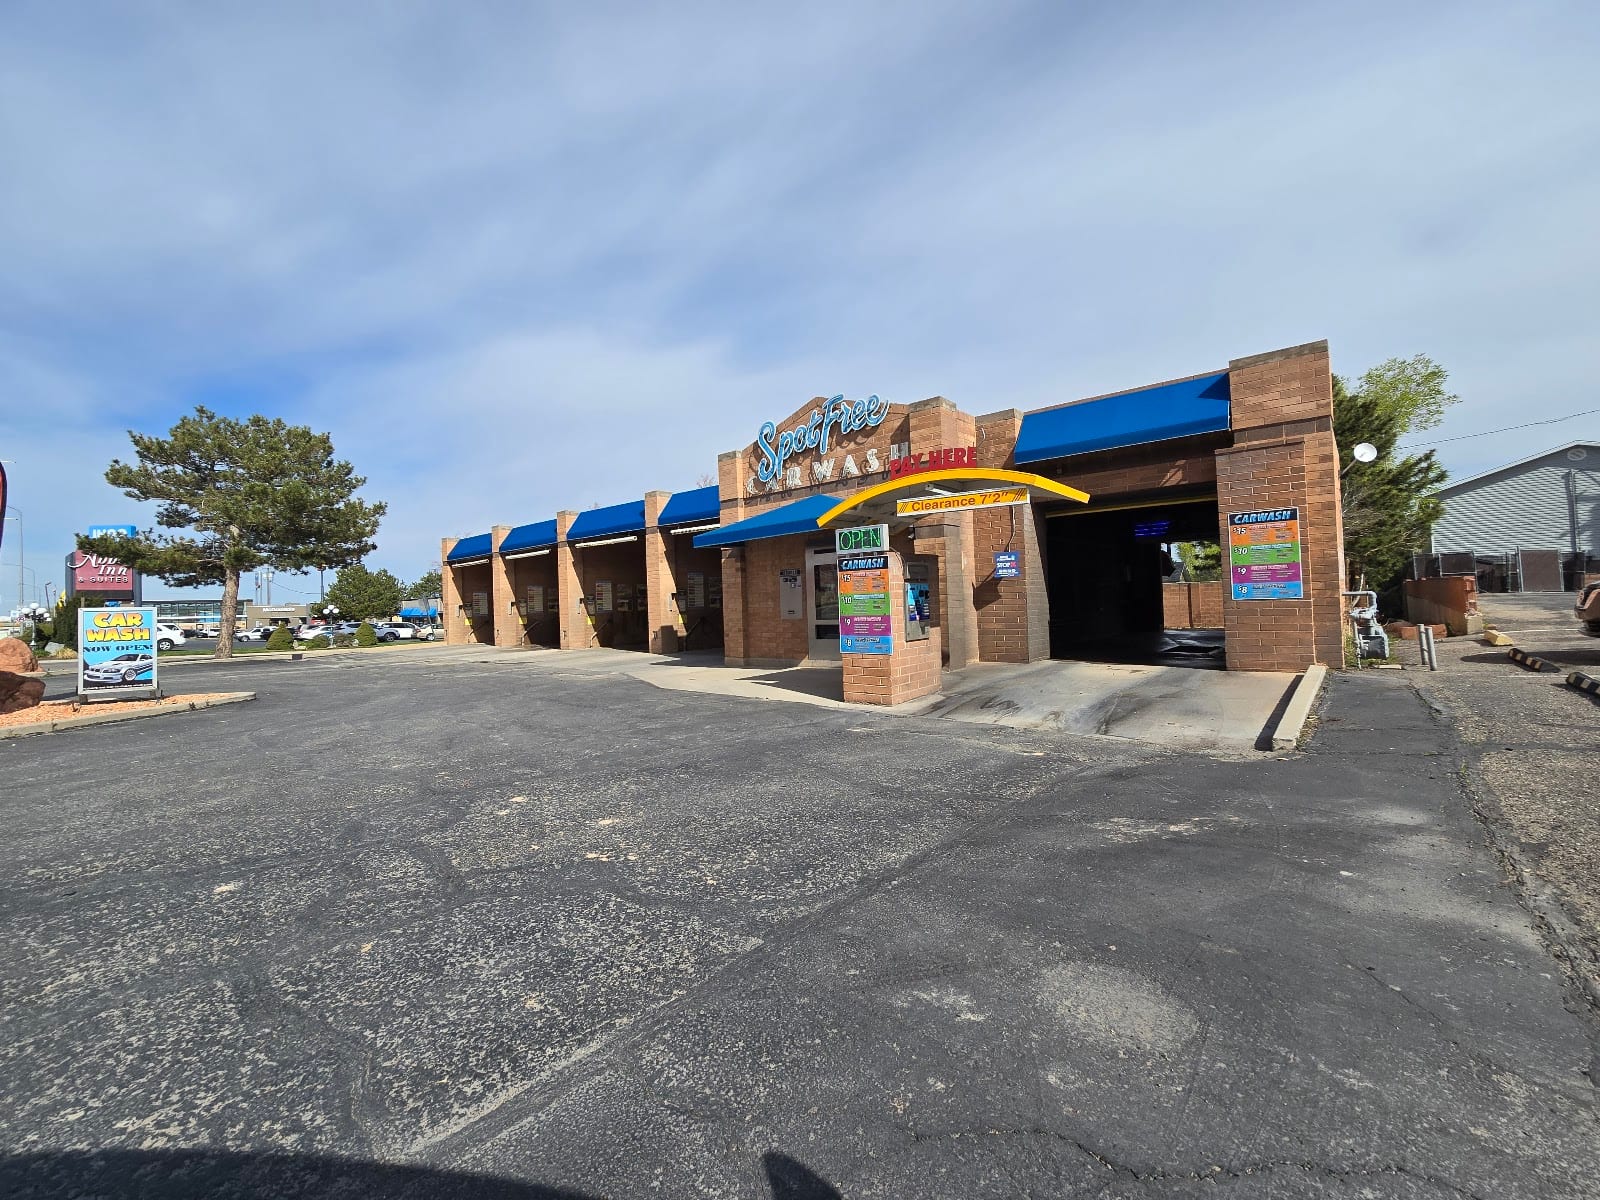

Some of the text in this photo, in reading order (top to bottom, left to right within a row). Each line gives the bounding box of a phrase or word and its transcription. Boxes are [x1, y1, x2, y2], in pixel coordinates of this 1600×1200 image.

[890, 446, 977, 479] PAY HERE
[911, 496, 976, 512] Clearance
[1234, 511, 1291, 523] CARWASH
[840, 527, 881, 550] OPEN
[98, 564, 128, 576] Inn
[842, 558, 884, 570] CARWASH
[90, 575, 129, 584] SUITES
[93, 612, 144, 628] CAR
[86, 627, 151, 642] WASH
[83, 645, 112, 653] NOW
